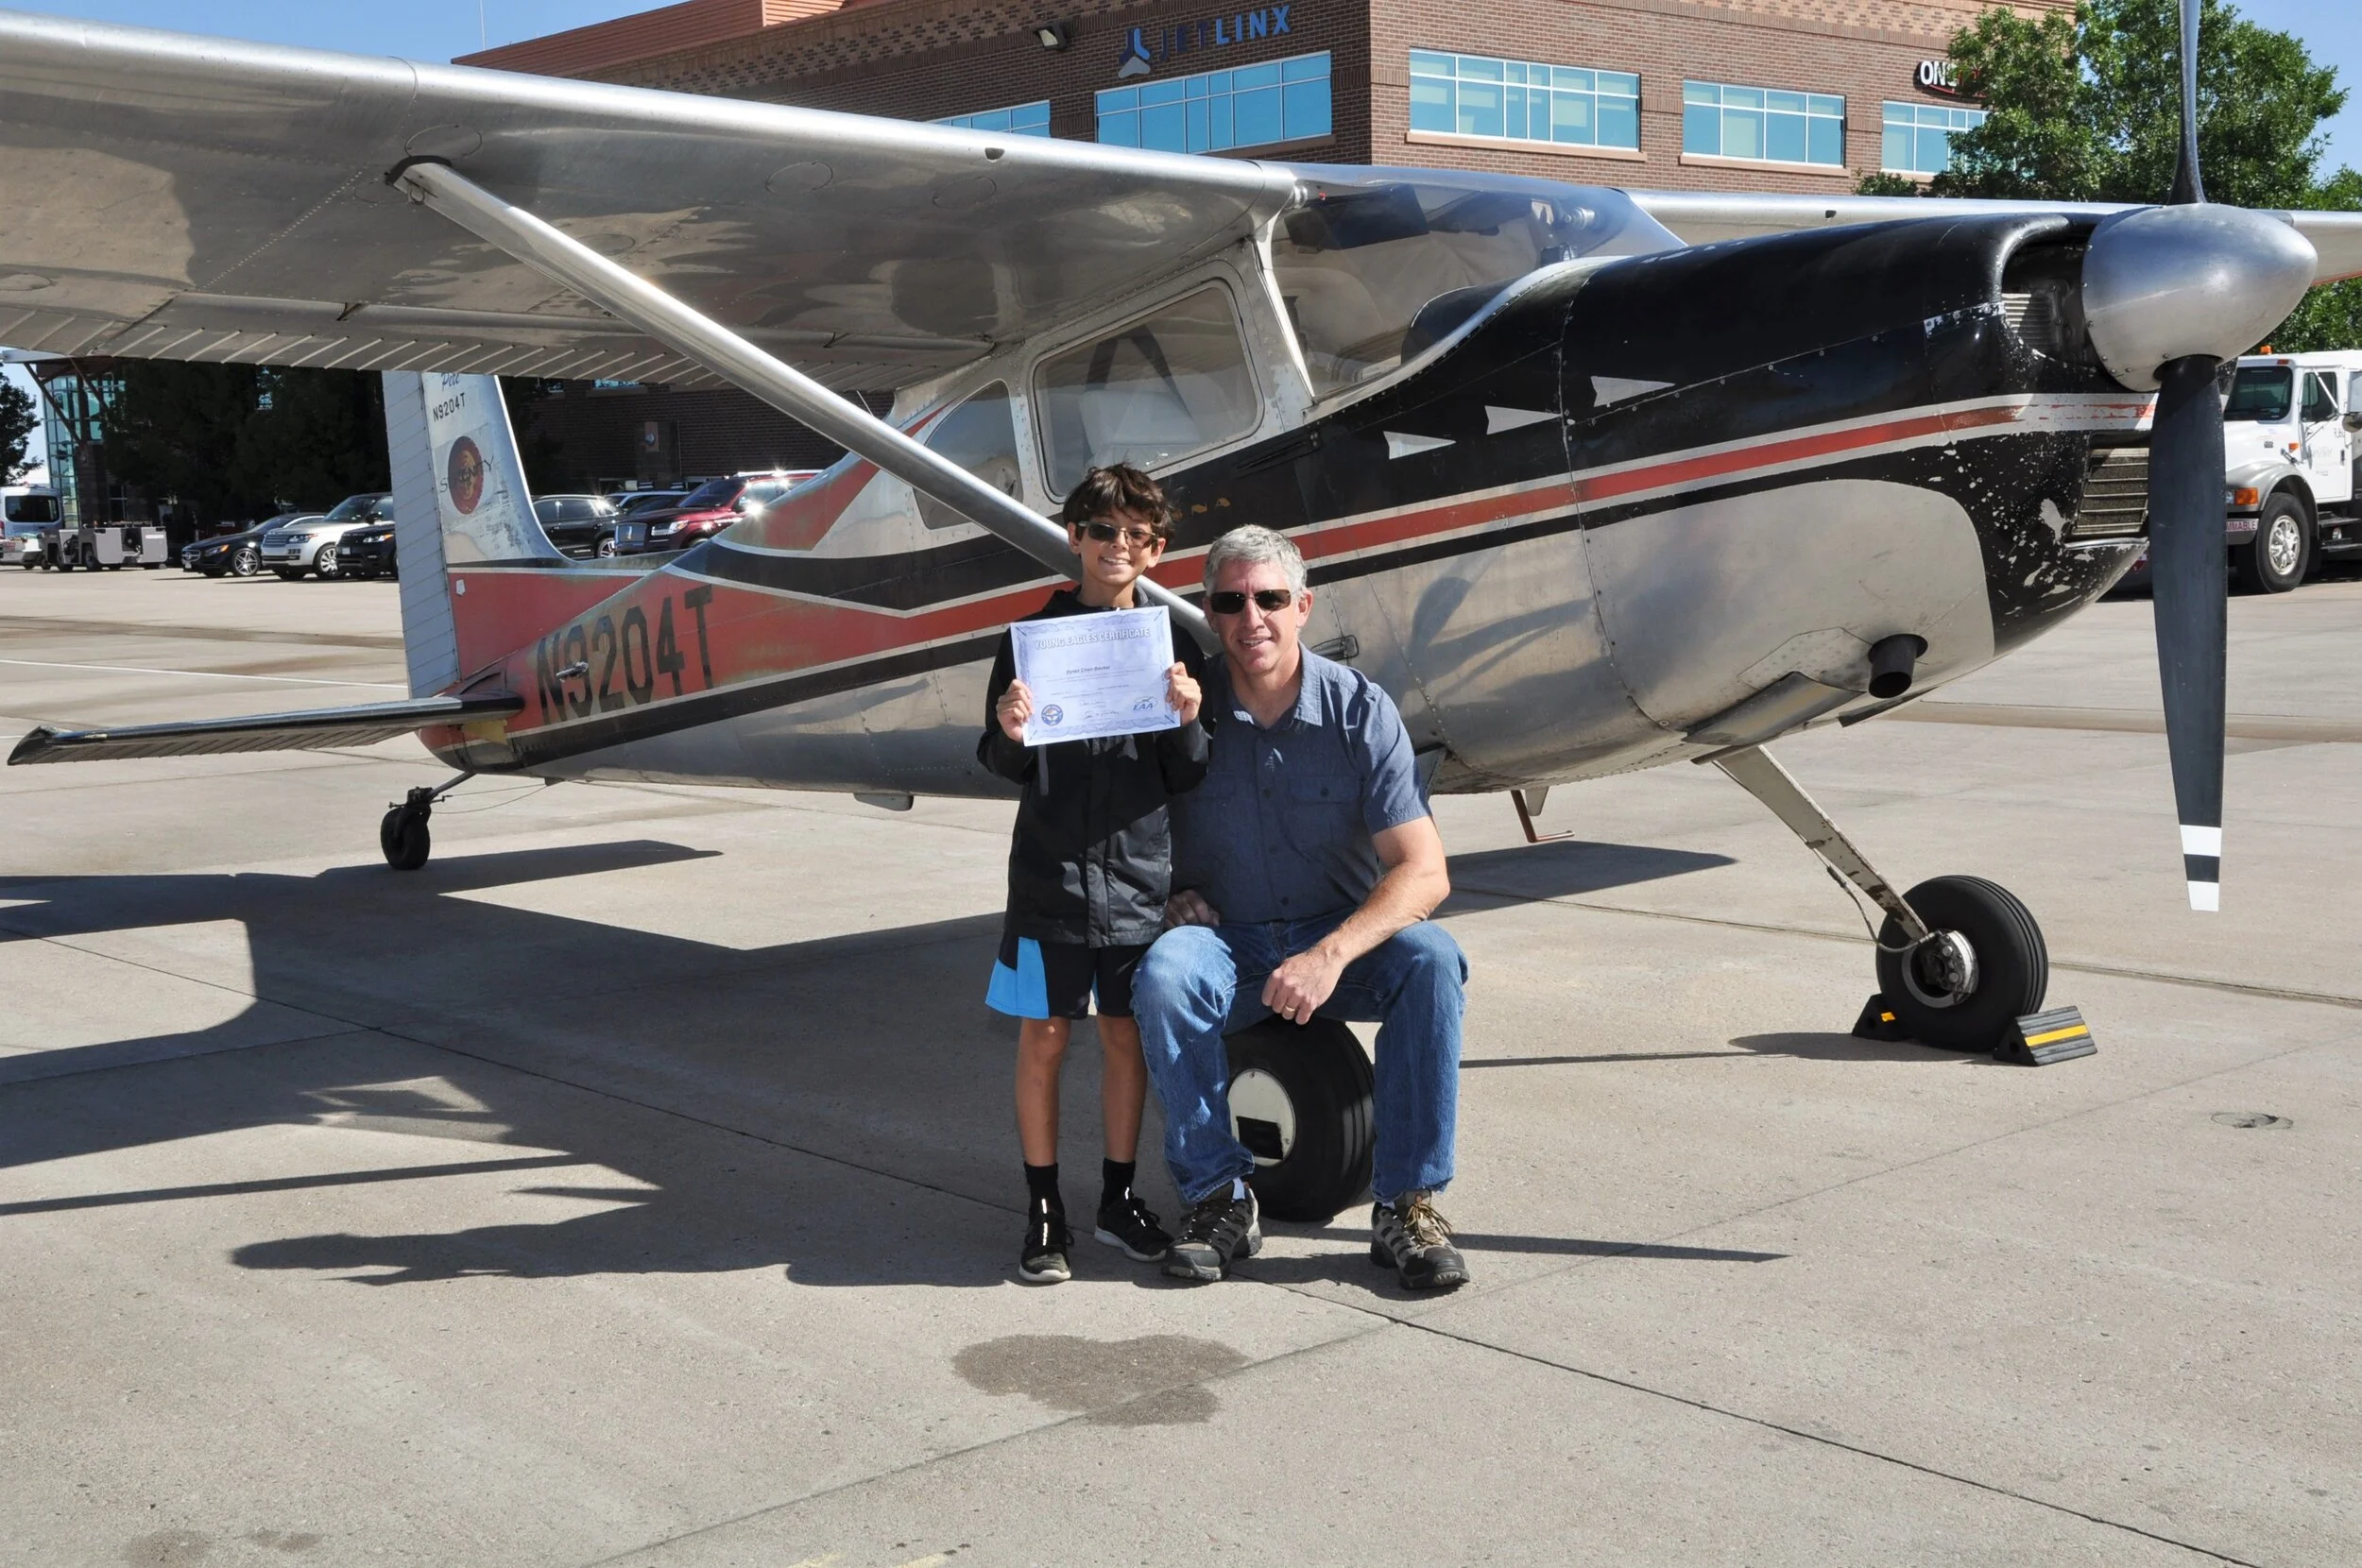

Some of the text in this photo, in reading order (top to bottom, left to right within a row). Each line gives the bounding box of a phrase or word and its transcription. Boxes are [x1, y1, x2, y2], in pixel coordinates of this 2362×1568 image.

[433, 392, 466, 422] N9204T
[1035, 627, 1151, 650] YOUNG EAGLES CERTIFICATE
[537, 584, 714, 725] N9204T
[1133, 702, 1154, 711] EAA
